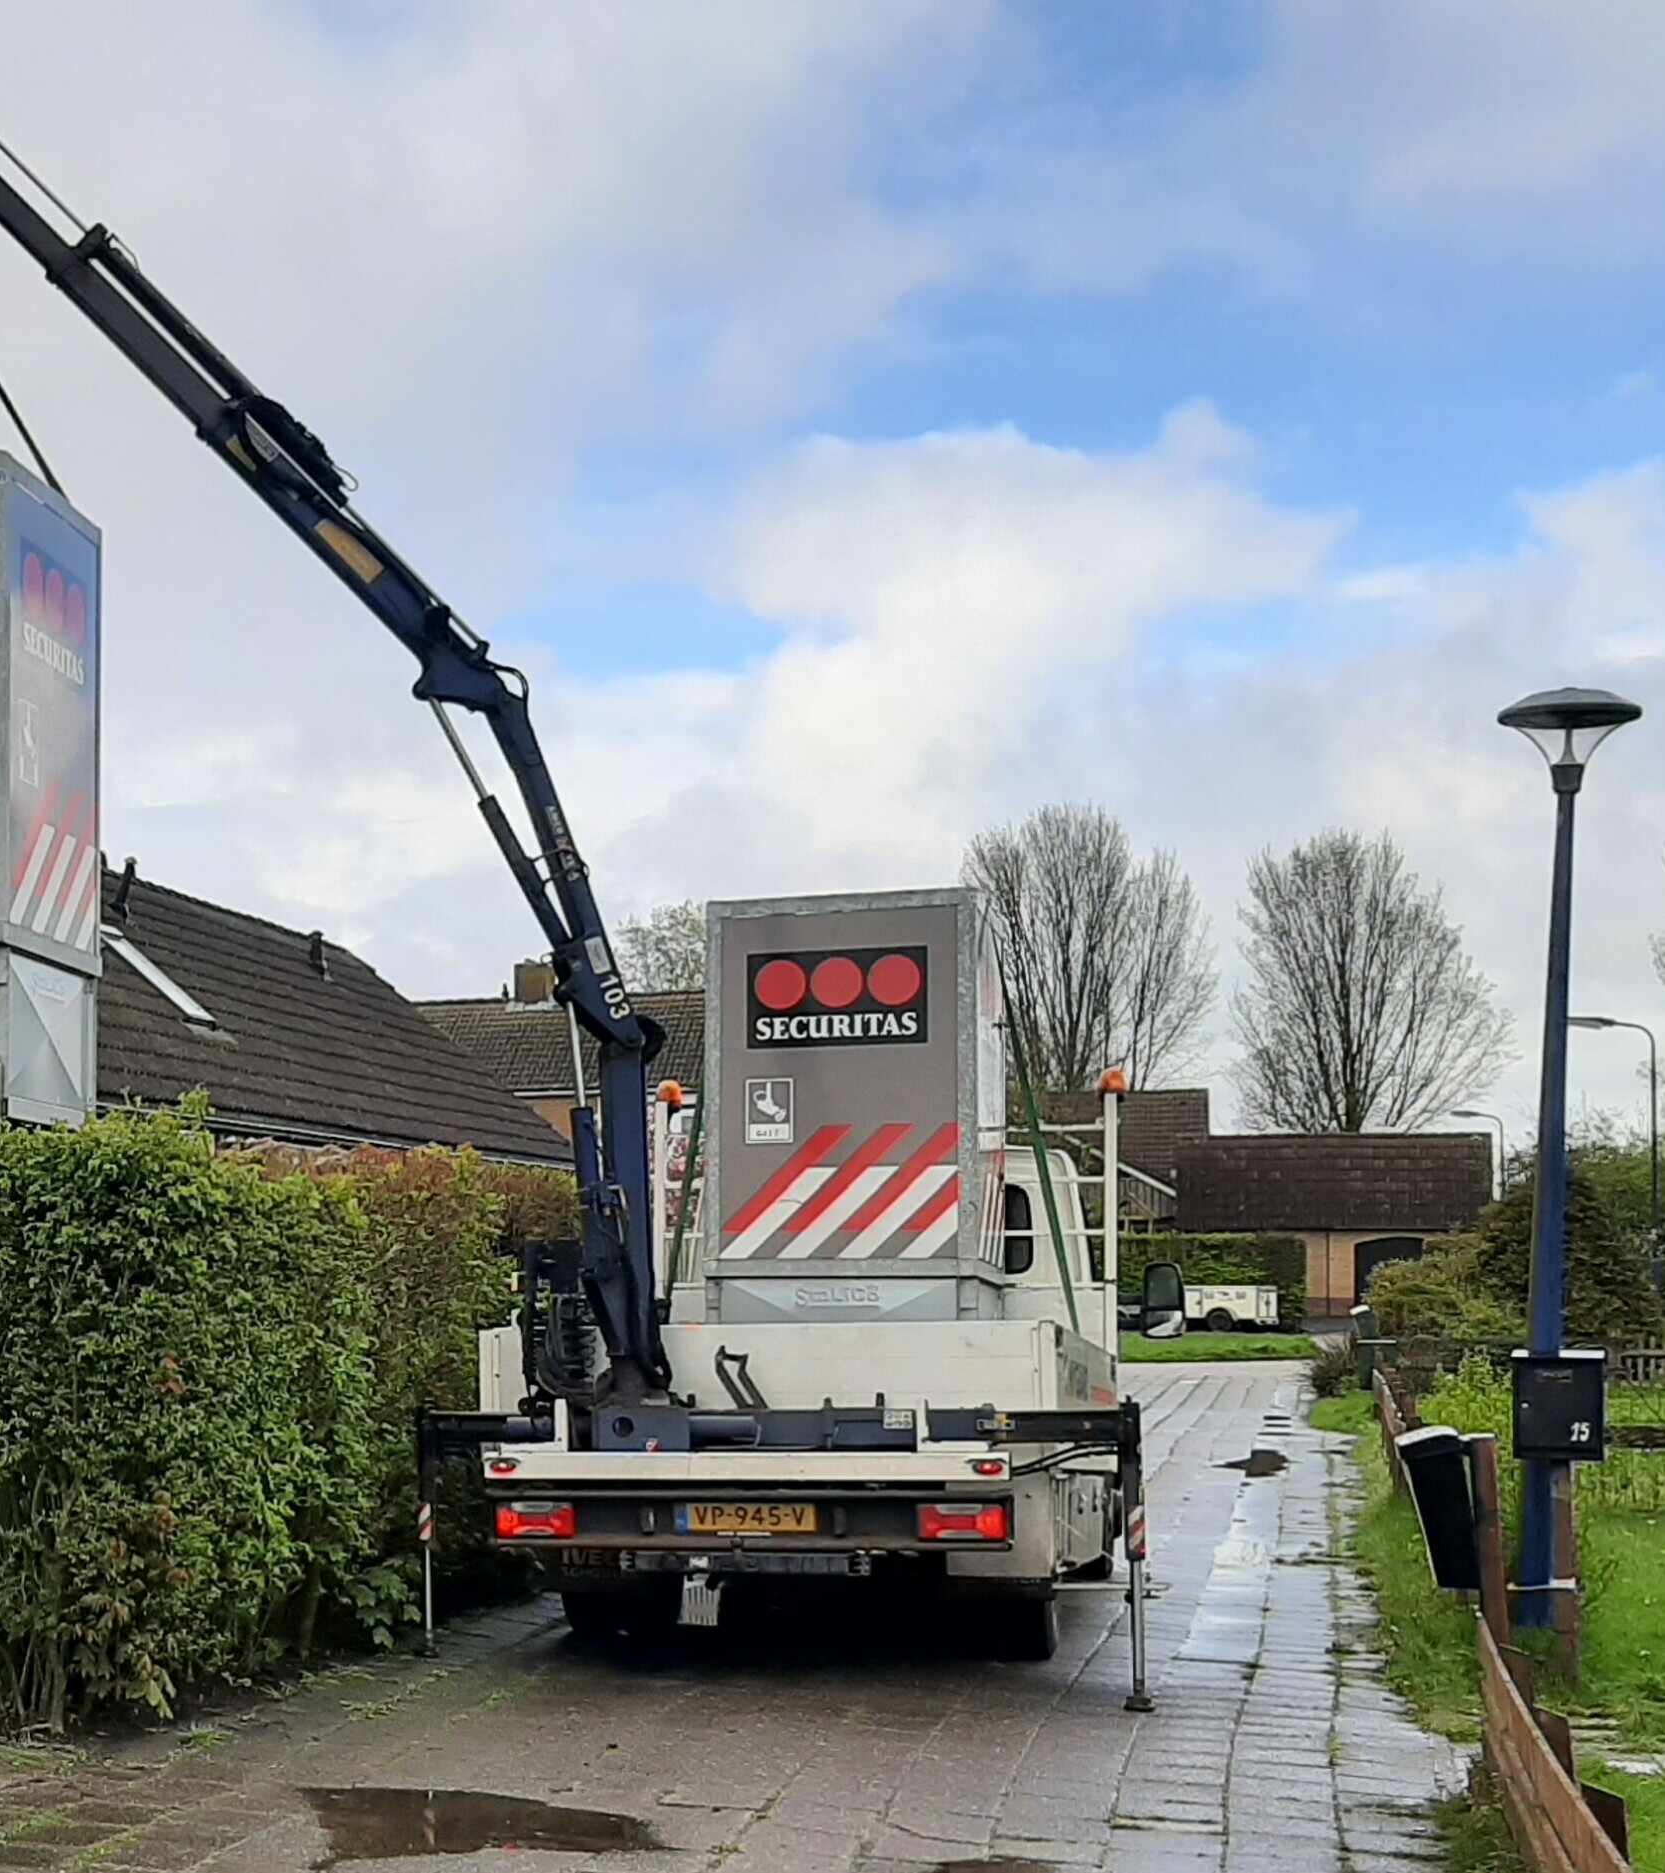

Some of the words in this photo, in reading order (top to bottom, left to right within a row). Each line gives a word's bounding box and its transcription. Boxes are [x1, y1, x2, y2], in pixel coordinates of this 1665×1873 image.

[22, 621, 85, 686] SECURITAS
[599, 974, 631, 1020] 103
[755, 1011, 919, 1041] SECURITAS
[1569, 1421, 1591, 1443] 15
[694, 1505, 806, 1527] VP-945-V
